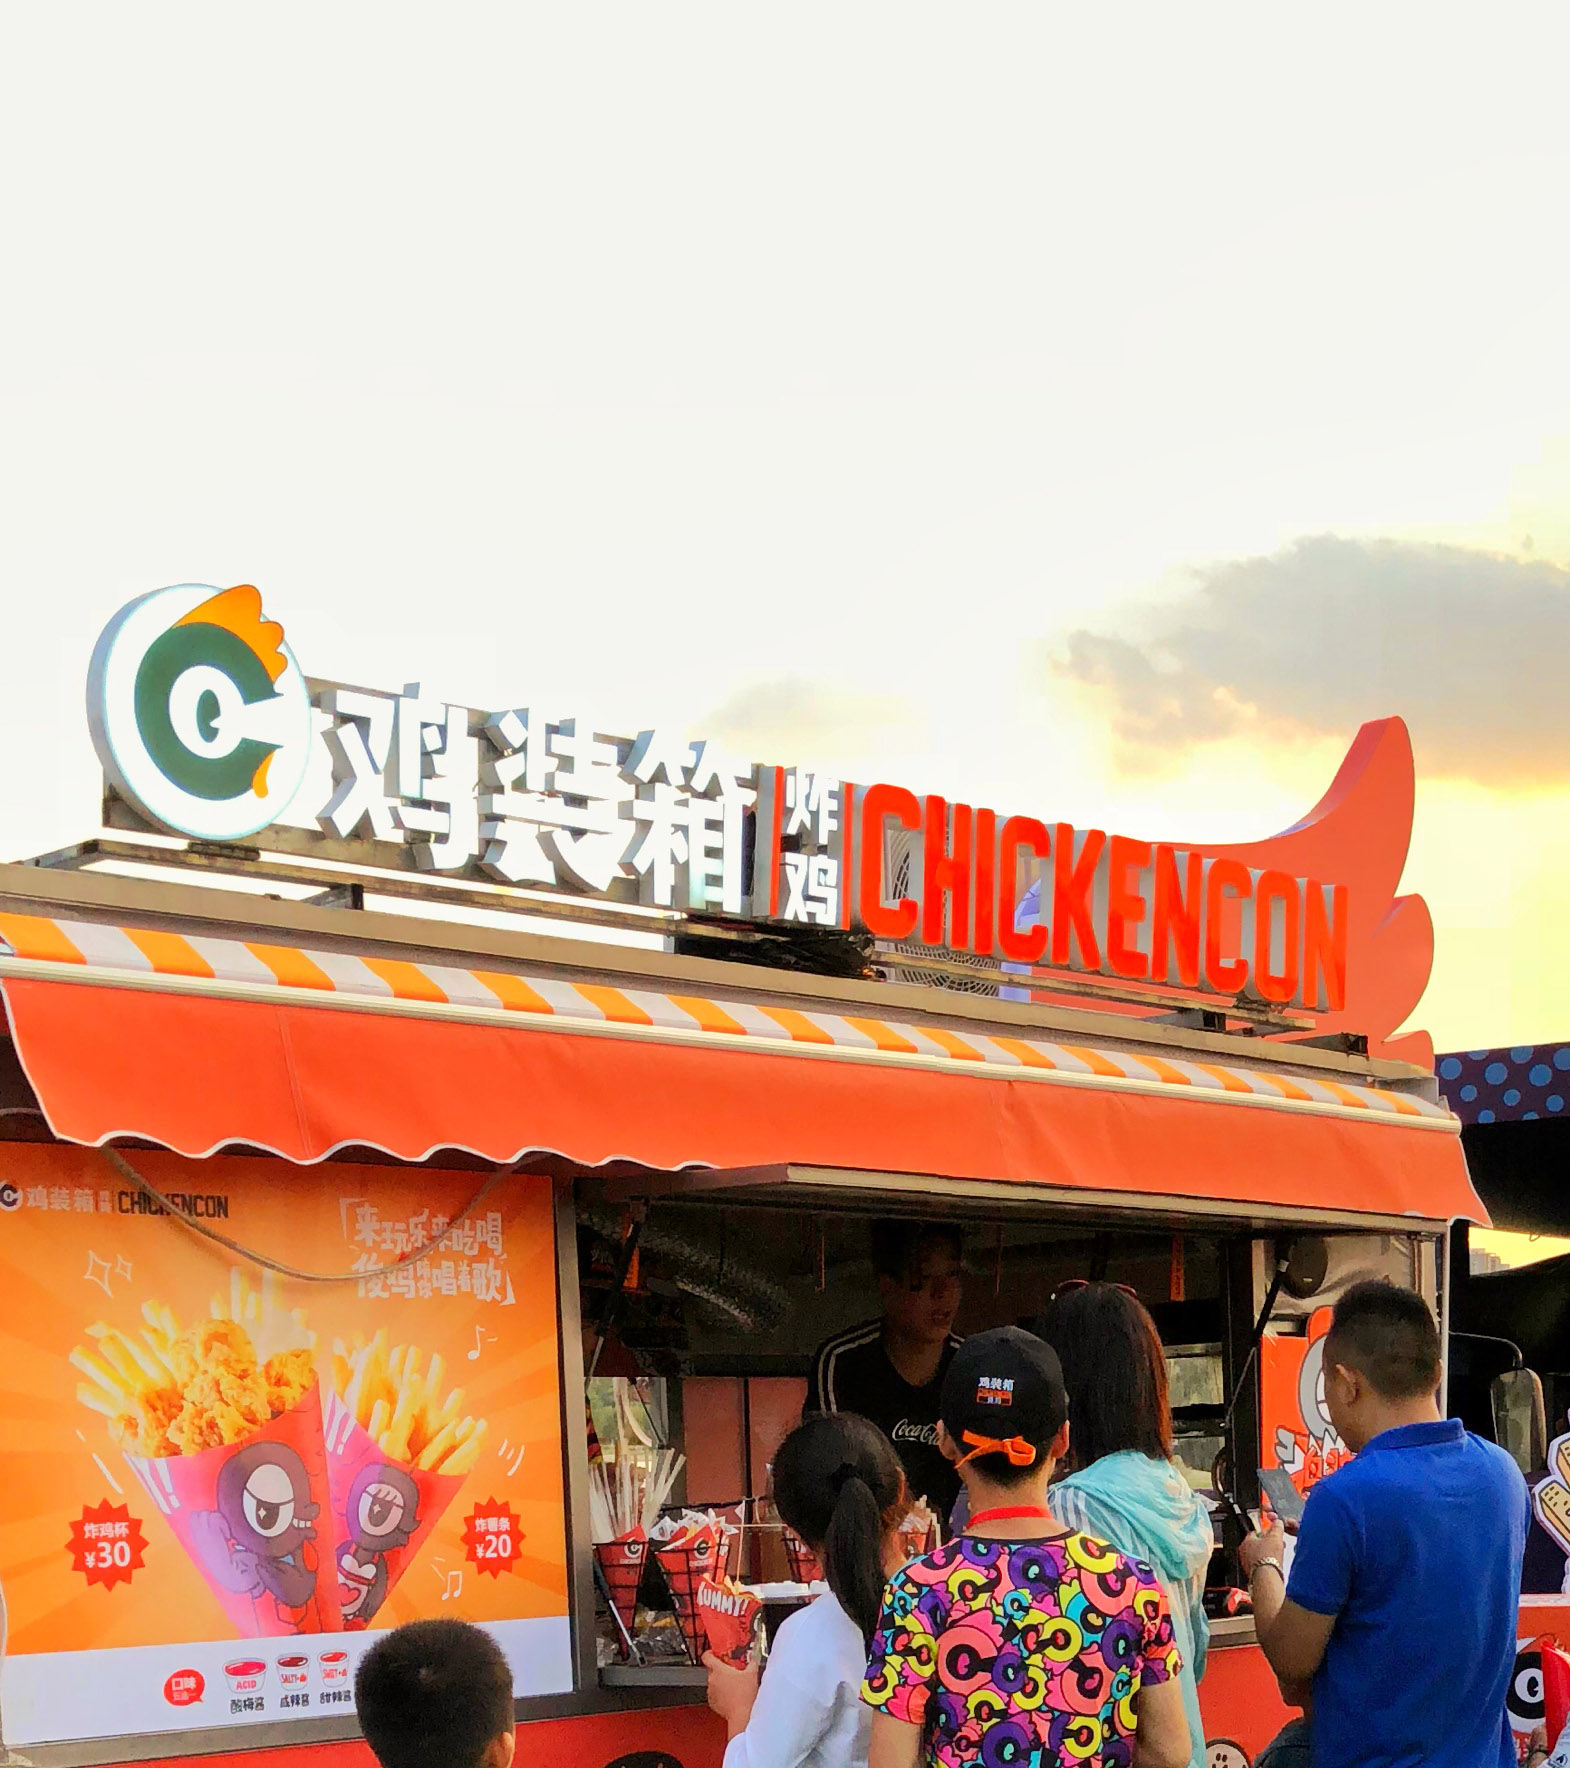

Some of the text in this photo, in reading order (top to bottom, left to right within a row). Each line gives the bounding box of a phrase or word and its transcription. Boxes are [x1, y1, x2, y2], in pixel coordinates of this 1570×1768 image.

[313, 682, 756, 914] 鸡装箱
[785, 767, 839, 925] 炸鸡
[861, 783, 1348, 1012] CHICKENCON
[83, 1521, 130, 1540] 炸鸡杯
[474, 1517, 511, 1533] 炸薯条
[84, 1542, 131, 1569] ¥30
[475, 1536, 512, 1560] ¥20
[172, 1677, 196, 1691] 口味
[236, 1680, 257, 1690] ACID
[230, 1697, 265, 1714] 酸梅酱
